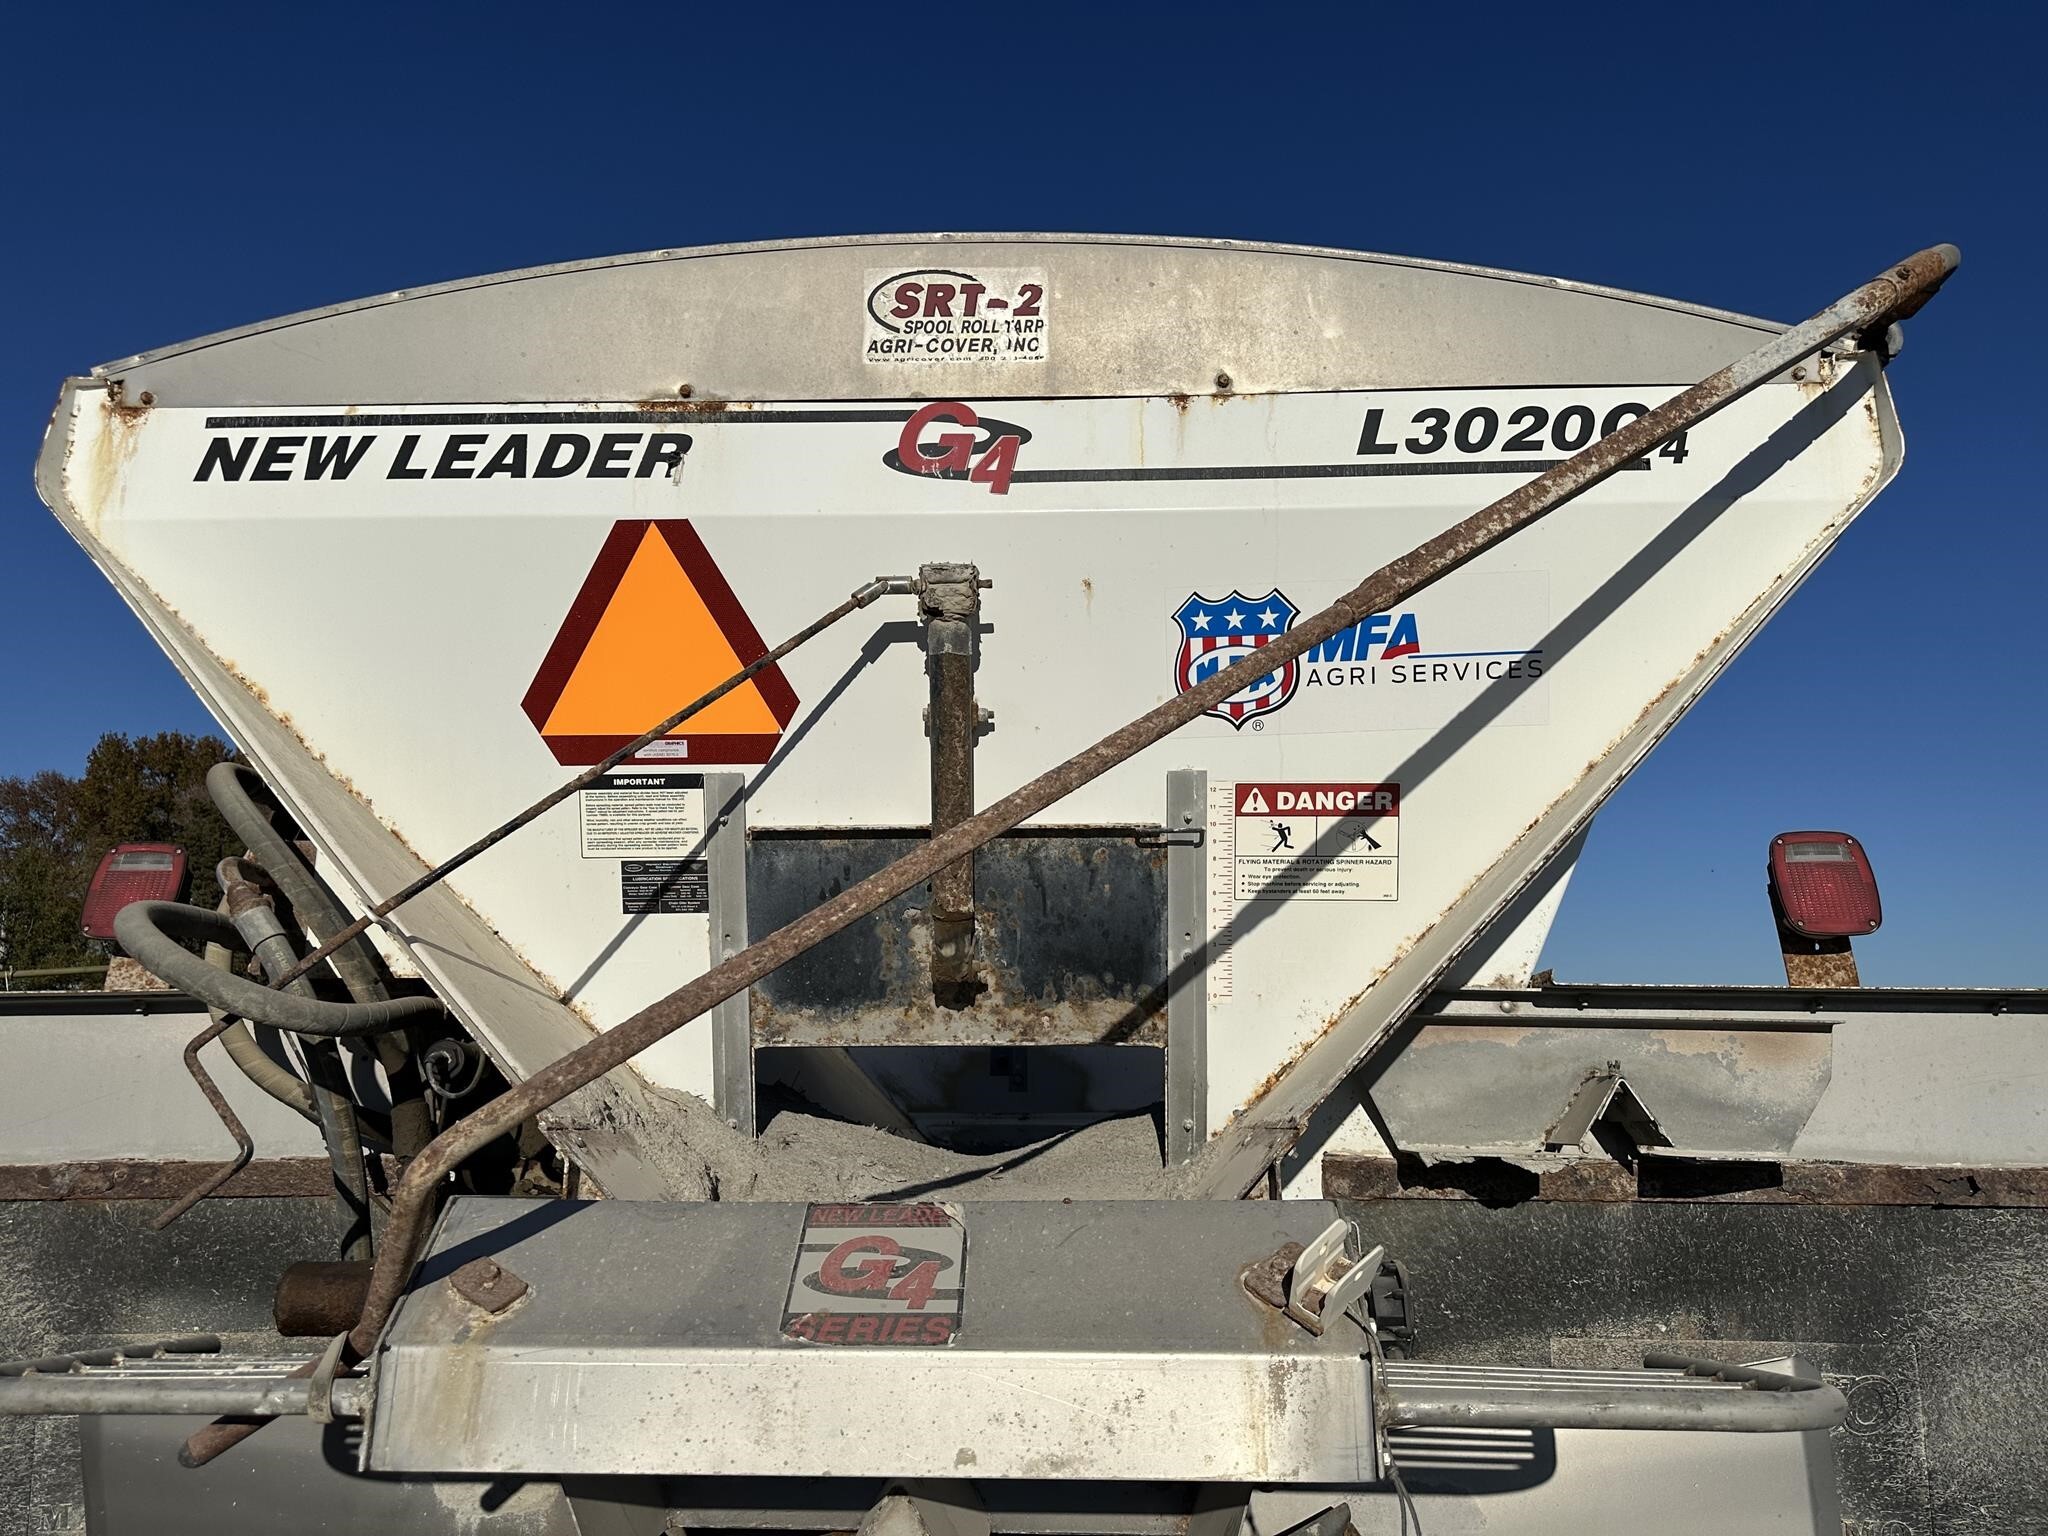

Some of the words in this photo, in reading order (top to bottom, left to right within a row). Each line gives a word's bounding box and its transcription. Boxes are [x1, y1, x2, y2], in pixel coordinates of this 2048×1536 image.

[890, 282, 1044, 319] SRT-2
[903, 319, 954, 335] SPOOL
[961, 319, 1000, 334] ROLL
[1005, 319, 1044, 334] TARP
[867, 338, 998, 355] AGRI-COVER,
[193, 435, 377, 482] NEW
[386, 432, 694, 480] LEADER
[897, 401, 1021, 495] G4
[1307, 613, 1421, 664] MFA
[1306, 666, 1376, 687] AGRI
[1391, 659, 1544, 684] SERVICES
[613, 778, 666, 786] IMPORTANT
[1276, 791, 1393, 811] DANGER
[811, 1206, 862, 1222] NEW
[818, 1235, 942, 1310] G4
[793, 1316, 955, 1344] SERIES
